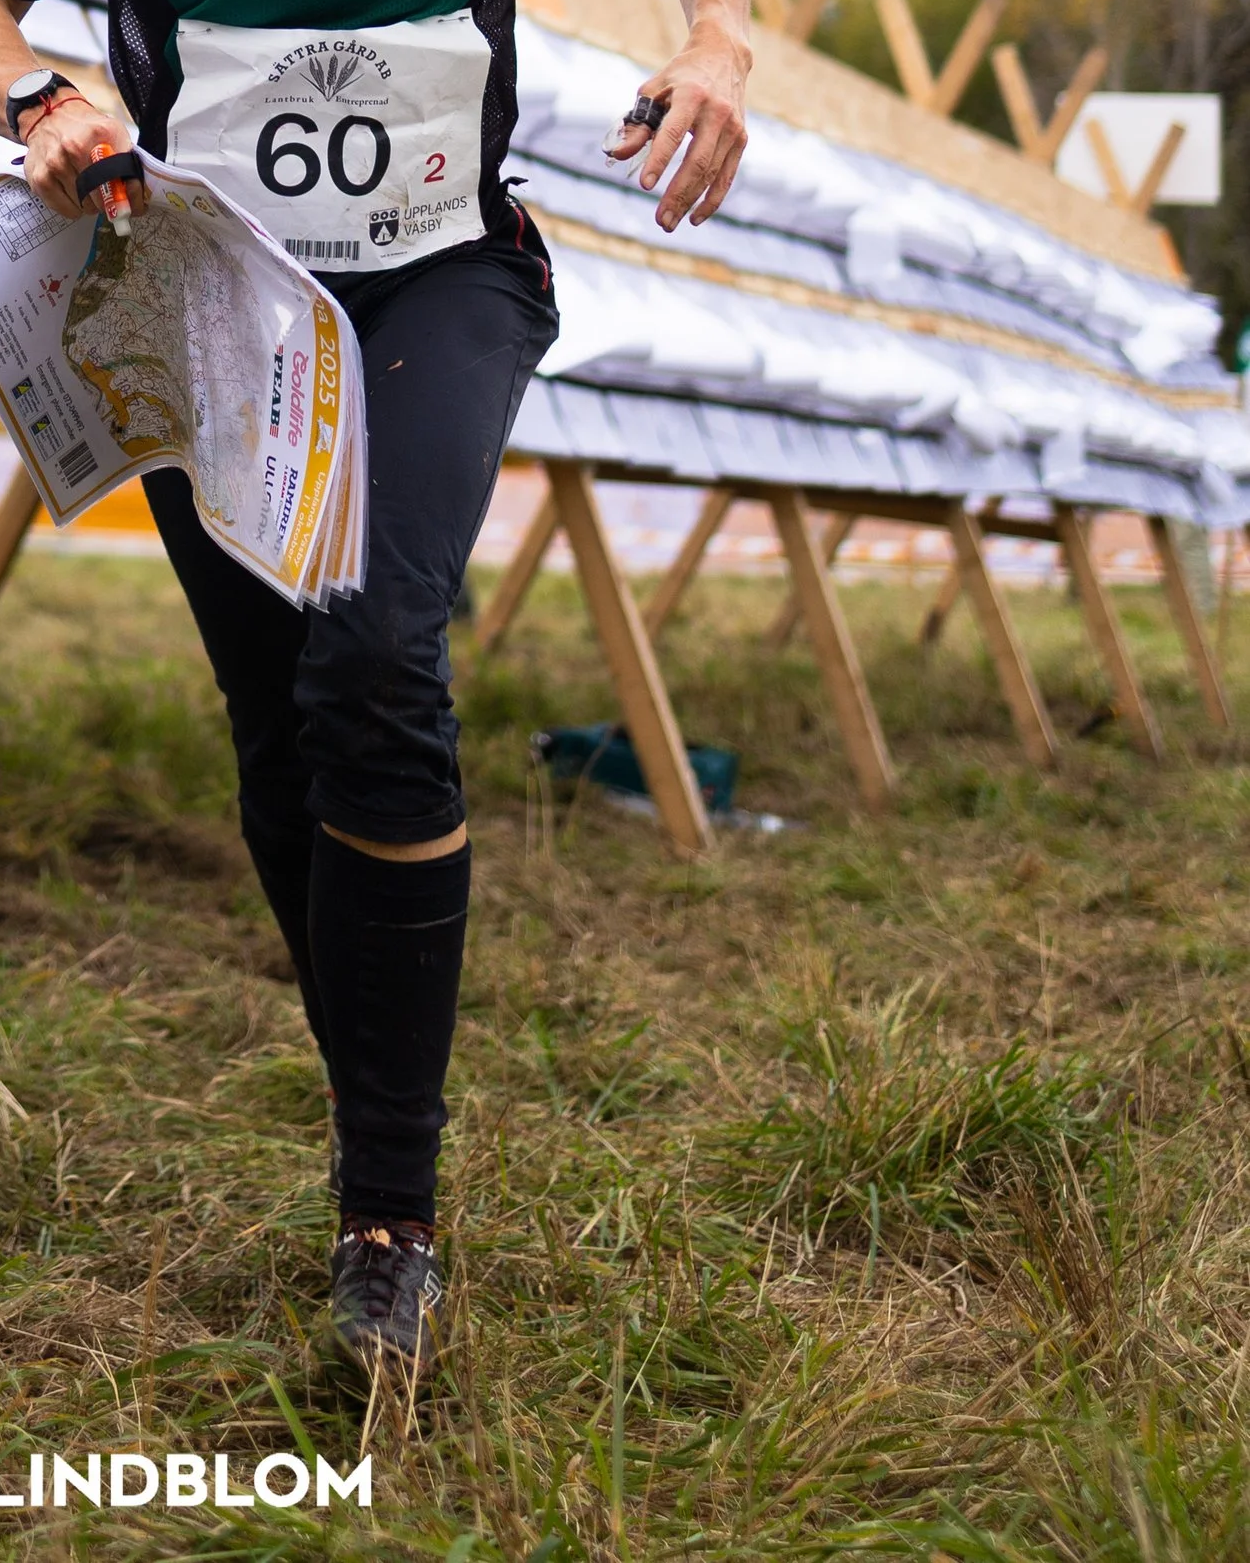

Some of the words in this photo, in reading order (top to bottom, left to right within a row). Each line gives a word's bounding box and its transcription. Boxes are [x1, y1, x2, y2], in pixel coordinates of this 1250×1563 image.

[268, 41, 329, 83] SÄTTRA
[333, 39, 378, 62] GÅRD
[375, 59, 392, 80] AB
[265, 95, 315, 105] Lantbruk
[335, 95, 389, 108] Entreprenad
[256, 112, 391, 197] 60
[424, 152, 446, 183] 2
[404, 195, 468, 221] UPPLANDS
[404, 217, 443, 237] VÄSBY
[267, 353, 286, 427] PEAB
[313, 335, 340, 406] 2025
[32, 363, 56, 397] Emergency
[49, 397, 66, 417] phone
[60, 417, 78, 441] number
[284, 349, 309, 447] Goldlife
[279, 470, 288, 499] LOXAM
[304, 470, 326, 529] Upplands
[272, 465, 298, 556] RAMIRENT
[273, 500, 283, 528] Compan
[285, 511, 306, 561] oktober
